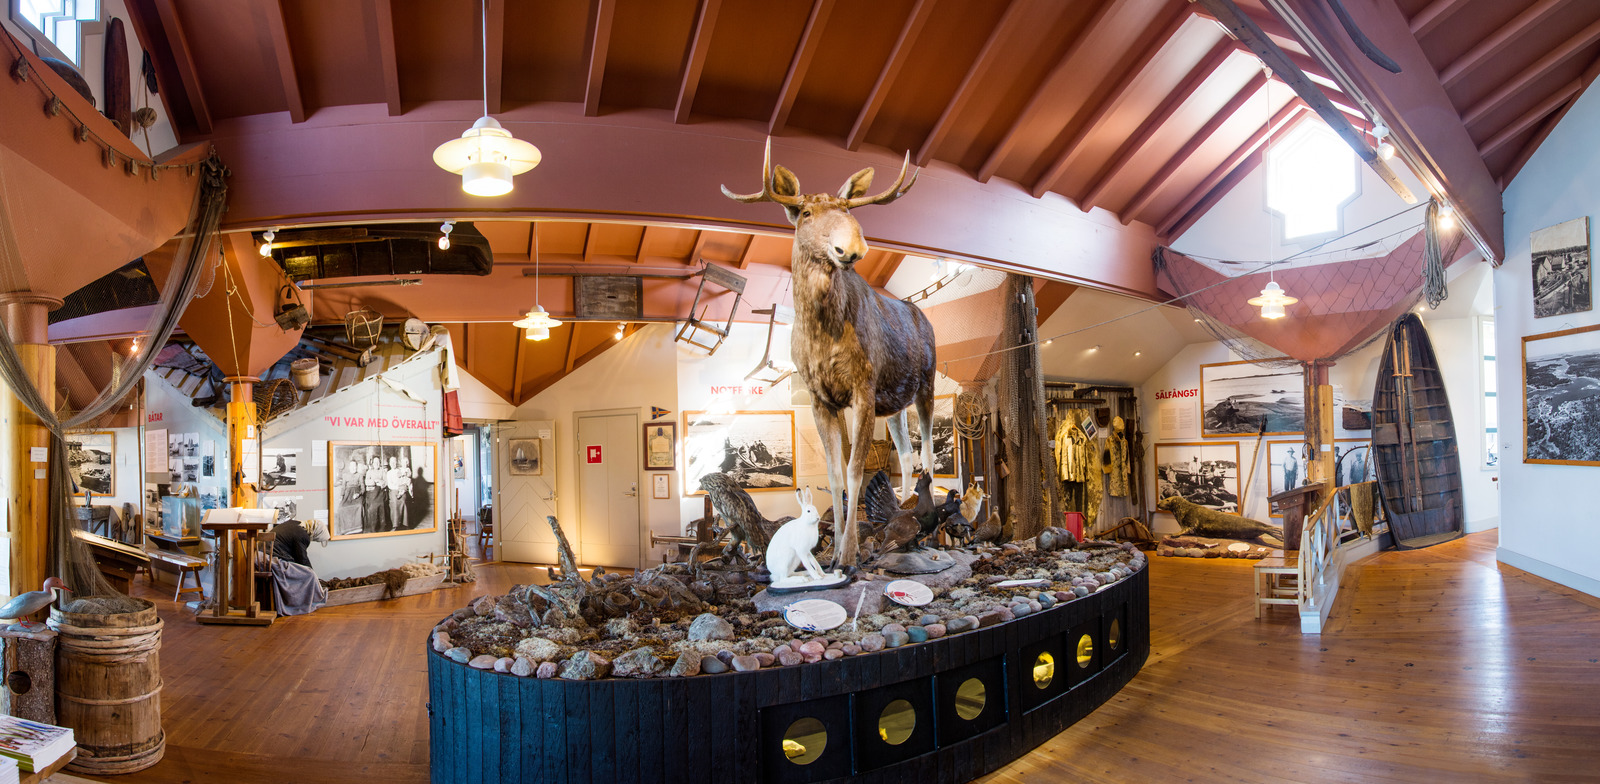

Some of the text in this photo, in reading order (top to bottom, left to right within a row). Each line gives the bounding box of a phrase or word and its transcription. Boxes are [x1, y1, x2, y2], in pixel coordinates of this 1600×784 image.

[1155, 388, 1199, 400] SÄLFÅNGST
[324, 415, 440, 430] "VI VAR MED ÖVERALLT"
